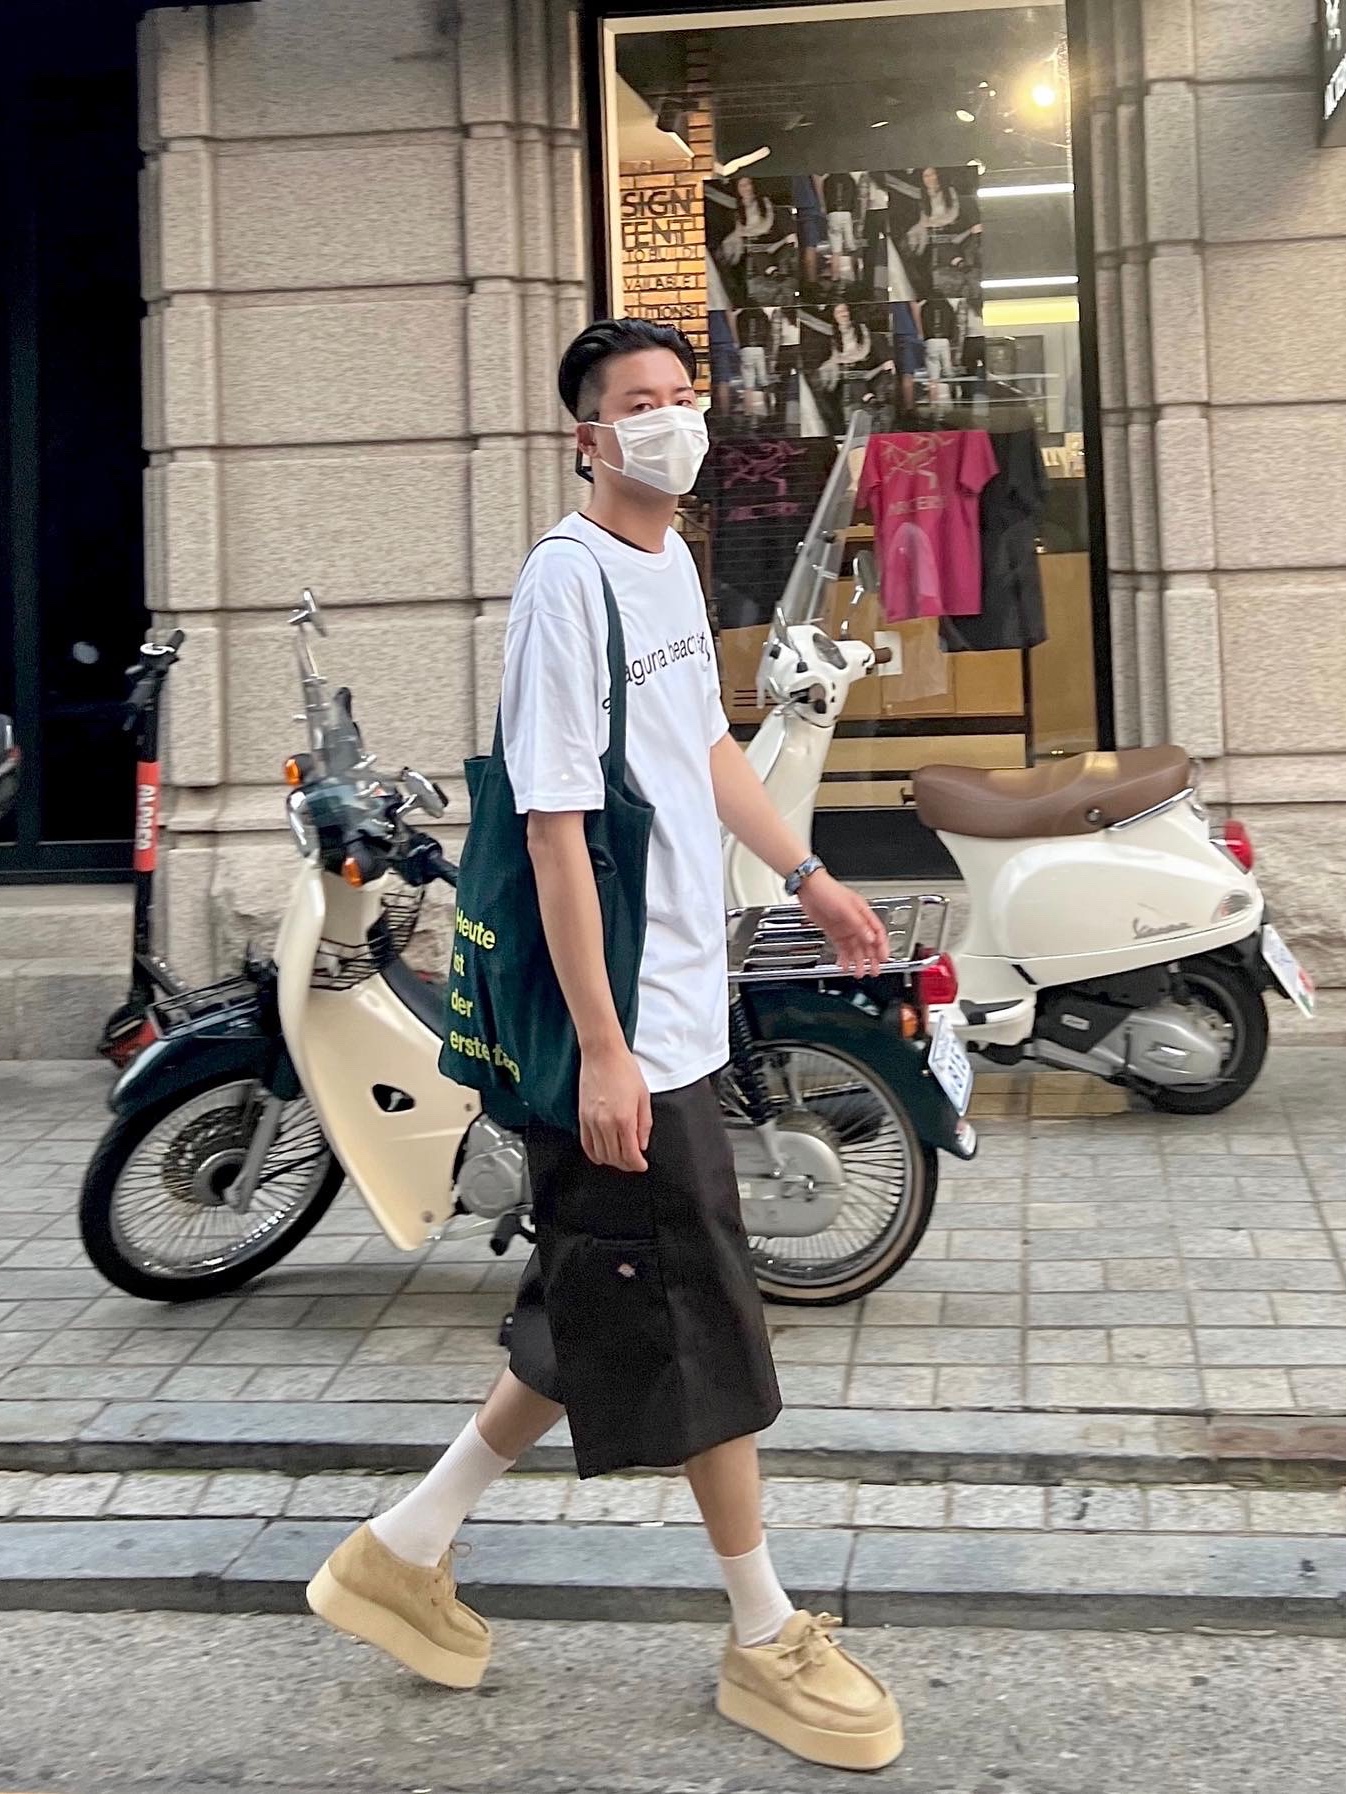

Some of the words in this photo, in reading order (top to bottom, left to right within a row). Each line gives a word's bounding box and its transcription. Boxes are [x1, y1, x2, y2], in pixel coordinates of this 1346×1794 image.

[455, 906, 497, 950] Heute
[451, 988, 474, 1018] der
[450, 1030, 491, 1062] erste
